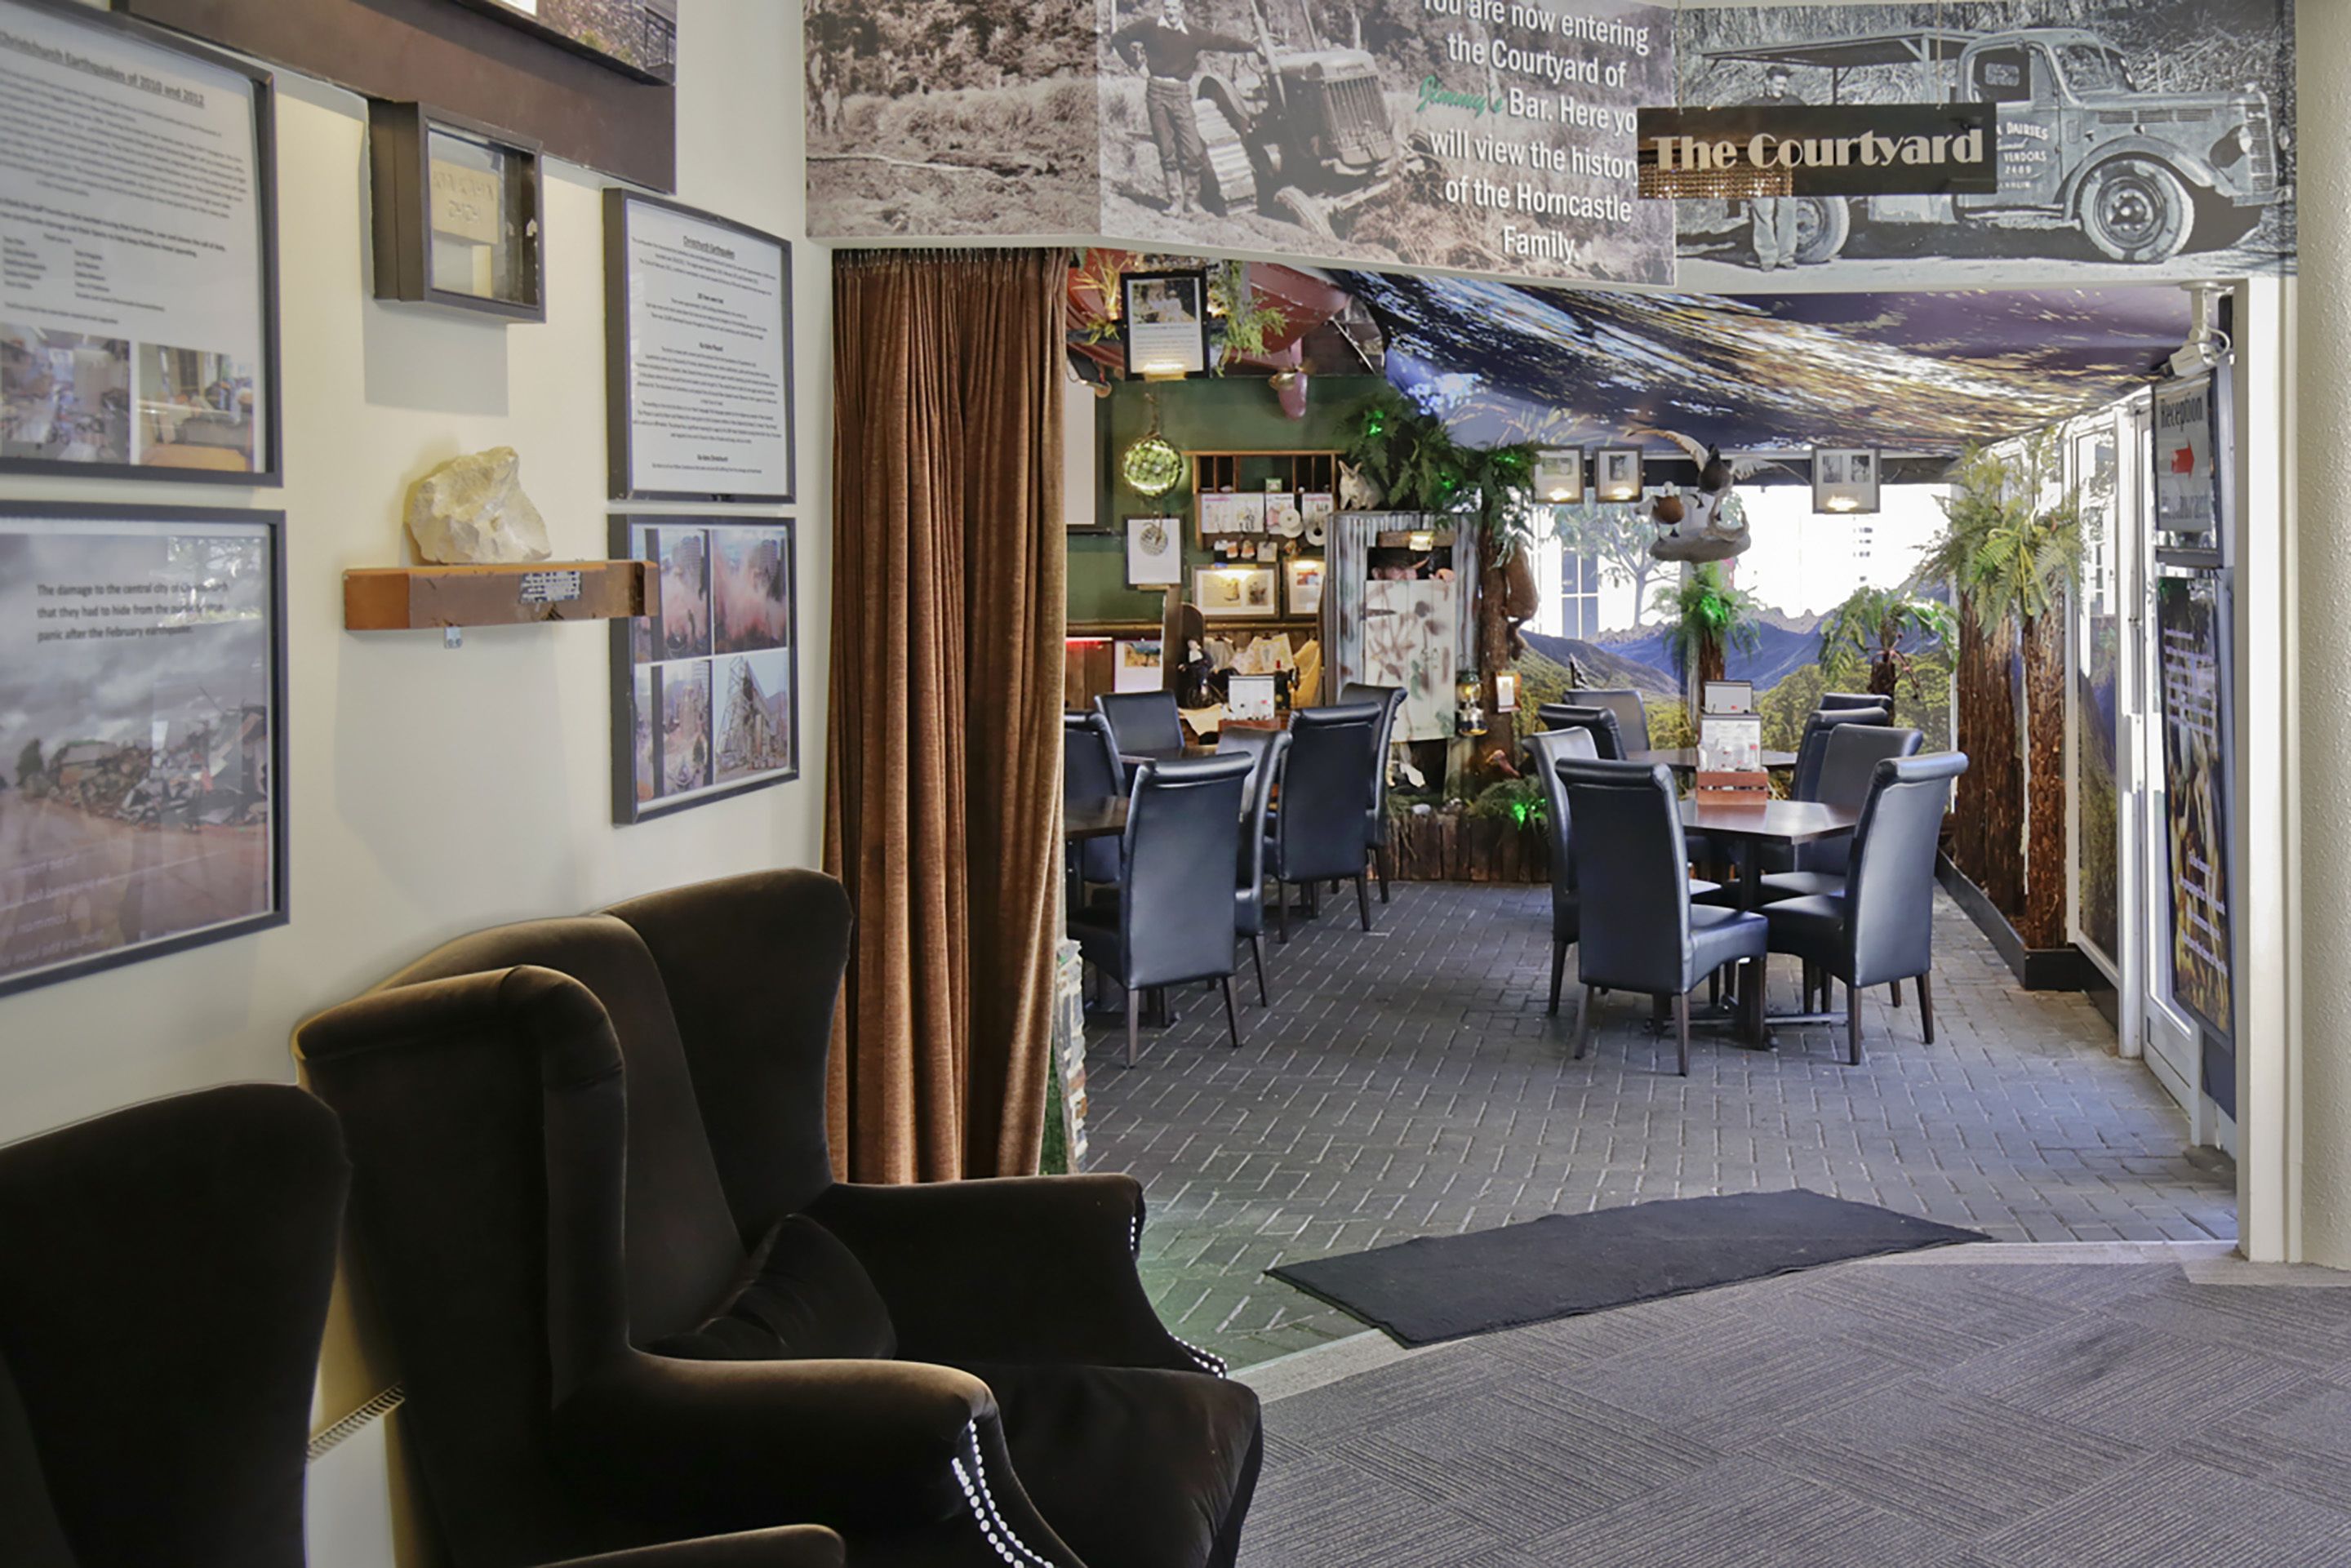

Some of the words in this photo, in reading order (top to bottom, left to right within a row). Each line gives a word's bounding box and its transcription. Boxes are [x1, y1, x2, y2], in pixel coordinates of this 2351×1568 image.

[1469, 0, 1505, 23] are
[1511, 4, 1555, 32] now
[1561, 14, 1650, 56] entering
[1447, 33, 1485, 64] the
[1491, 39, 1598, 84] Courtyard
[1605, 61, 1626, 88] of
[163, 85, 182, 101] and
[1509, 87, 1553, 121] Bar.
[1560, 96, 1609, 128] Here
[1614, 109, 1638, 137] yo
[1430, 128, 1469, 159] will
[1473, 135, 1526, 166] view
[1530, 141, 1566, 170] the
[1650, 135, 1738, 170] The
[1748, 129, 1983, 168] Courtyard
[2006, 121, 2048, 140] DAIRIES
[2003, 151, 2047, 162] VENDORS
[1445, 175, 1468, 202] of
[1473, 179, 1510, 207] the
[1517, 182, 1632, 223] Horncastle
[1503, 226, 1580, 264] Family.
[2160, 392, 2204, 433] Reception
[37, 584, 54, 596] The
[57, 584, 92, 597] damage
[94, 584, 104, 595] to
[106, 583, 121, 594] the
[122, 582, 152, 594] central
[37, 606, 56, 619] that
[59, 606, 79, 620] they
[81, 605, 99, 617] had
[100, 606, 110, 616] to
[112, 604, 131, 615] hide
[132, 604, 153, 615] from
[154, 603, 169, 615] the
[38, 629, 63, 644] panic
[64, 627, 87, 640] after
[88, 627, 104, 638] the
[105, 625, 143, 638] February
